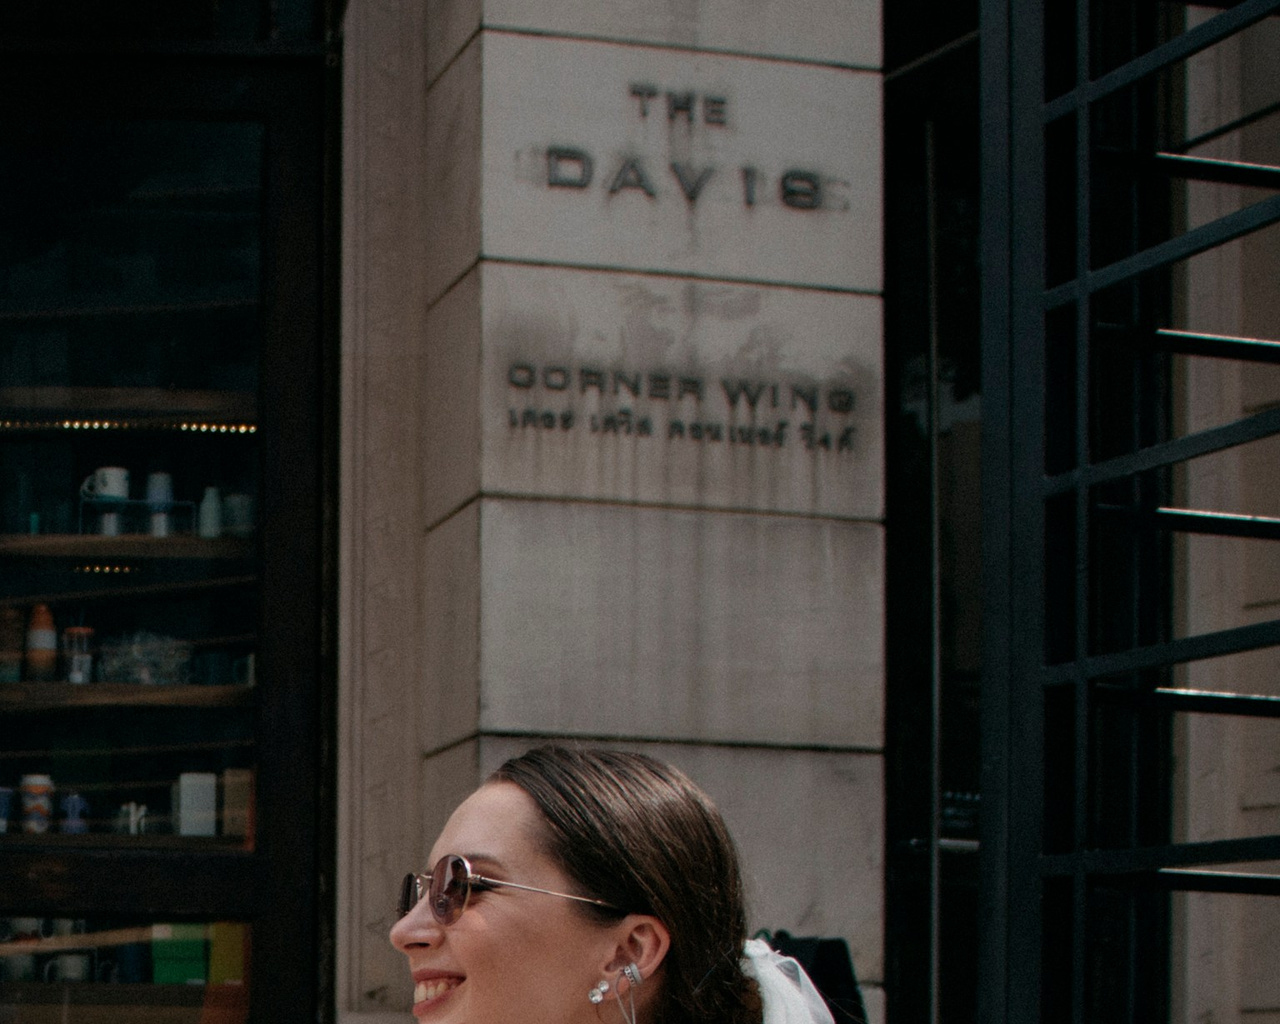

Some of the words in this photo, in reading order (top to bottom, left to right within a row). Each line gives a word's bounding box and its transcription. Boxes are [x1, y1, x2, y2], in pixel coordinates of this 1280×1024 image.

[628, 83, 727, 127] THE
[546, 144, 822, 211] DAVIS
[507, 363, 703, 401] CORNER
[720, 376, 857, 414] WING
